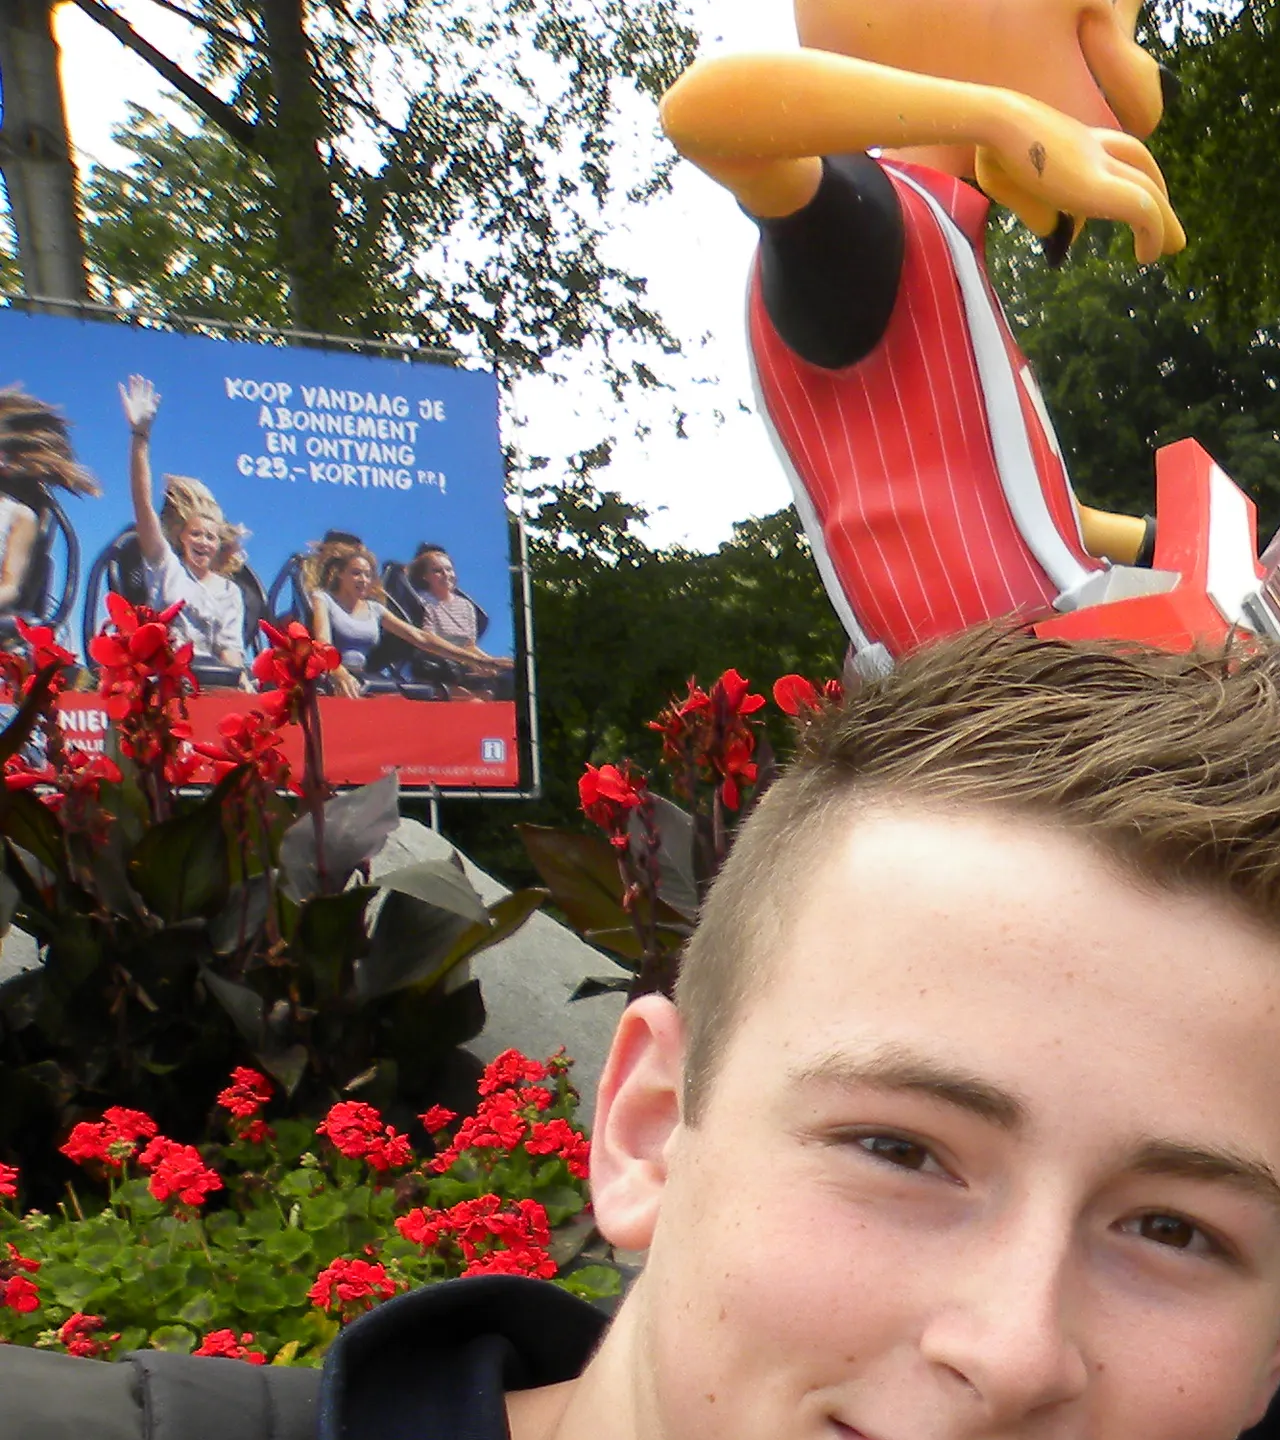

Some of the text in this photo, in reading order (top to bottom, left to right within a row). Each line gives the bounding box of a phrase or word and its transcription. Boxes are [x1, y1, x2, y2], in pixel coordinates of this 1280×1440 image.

[224, 376, 447, 421] KOOP VANDAAG JE
[258, 404, 421, 443] ABONNEMENT
[266, 431, 416, 466] EN ONTVANG
[309, 461, 412, 490] KORTING
